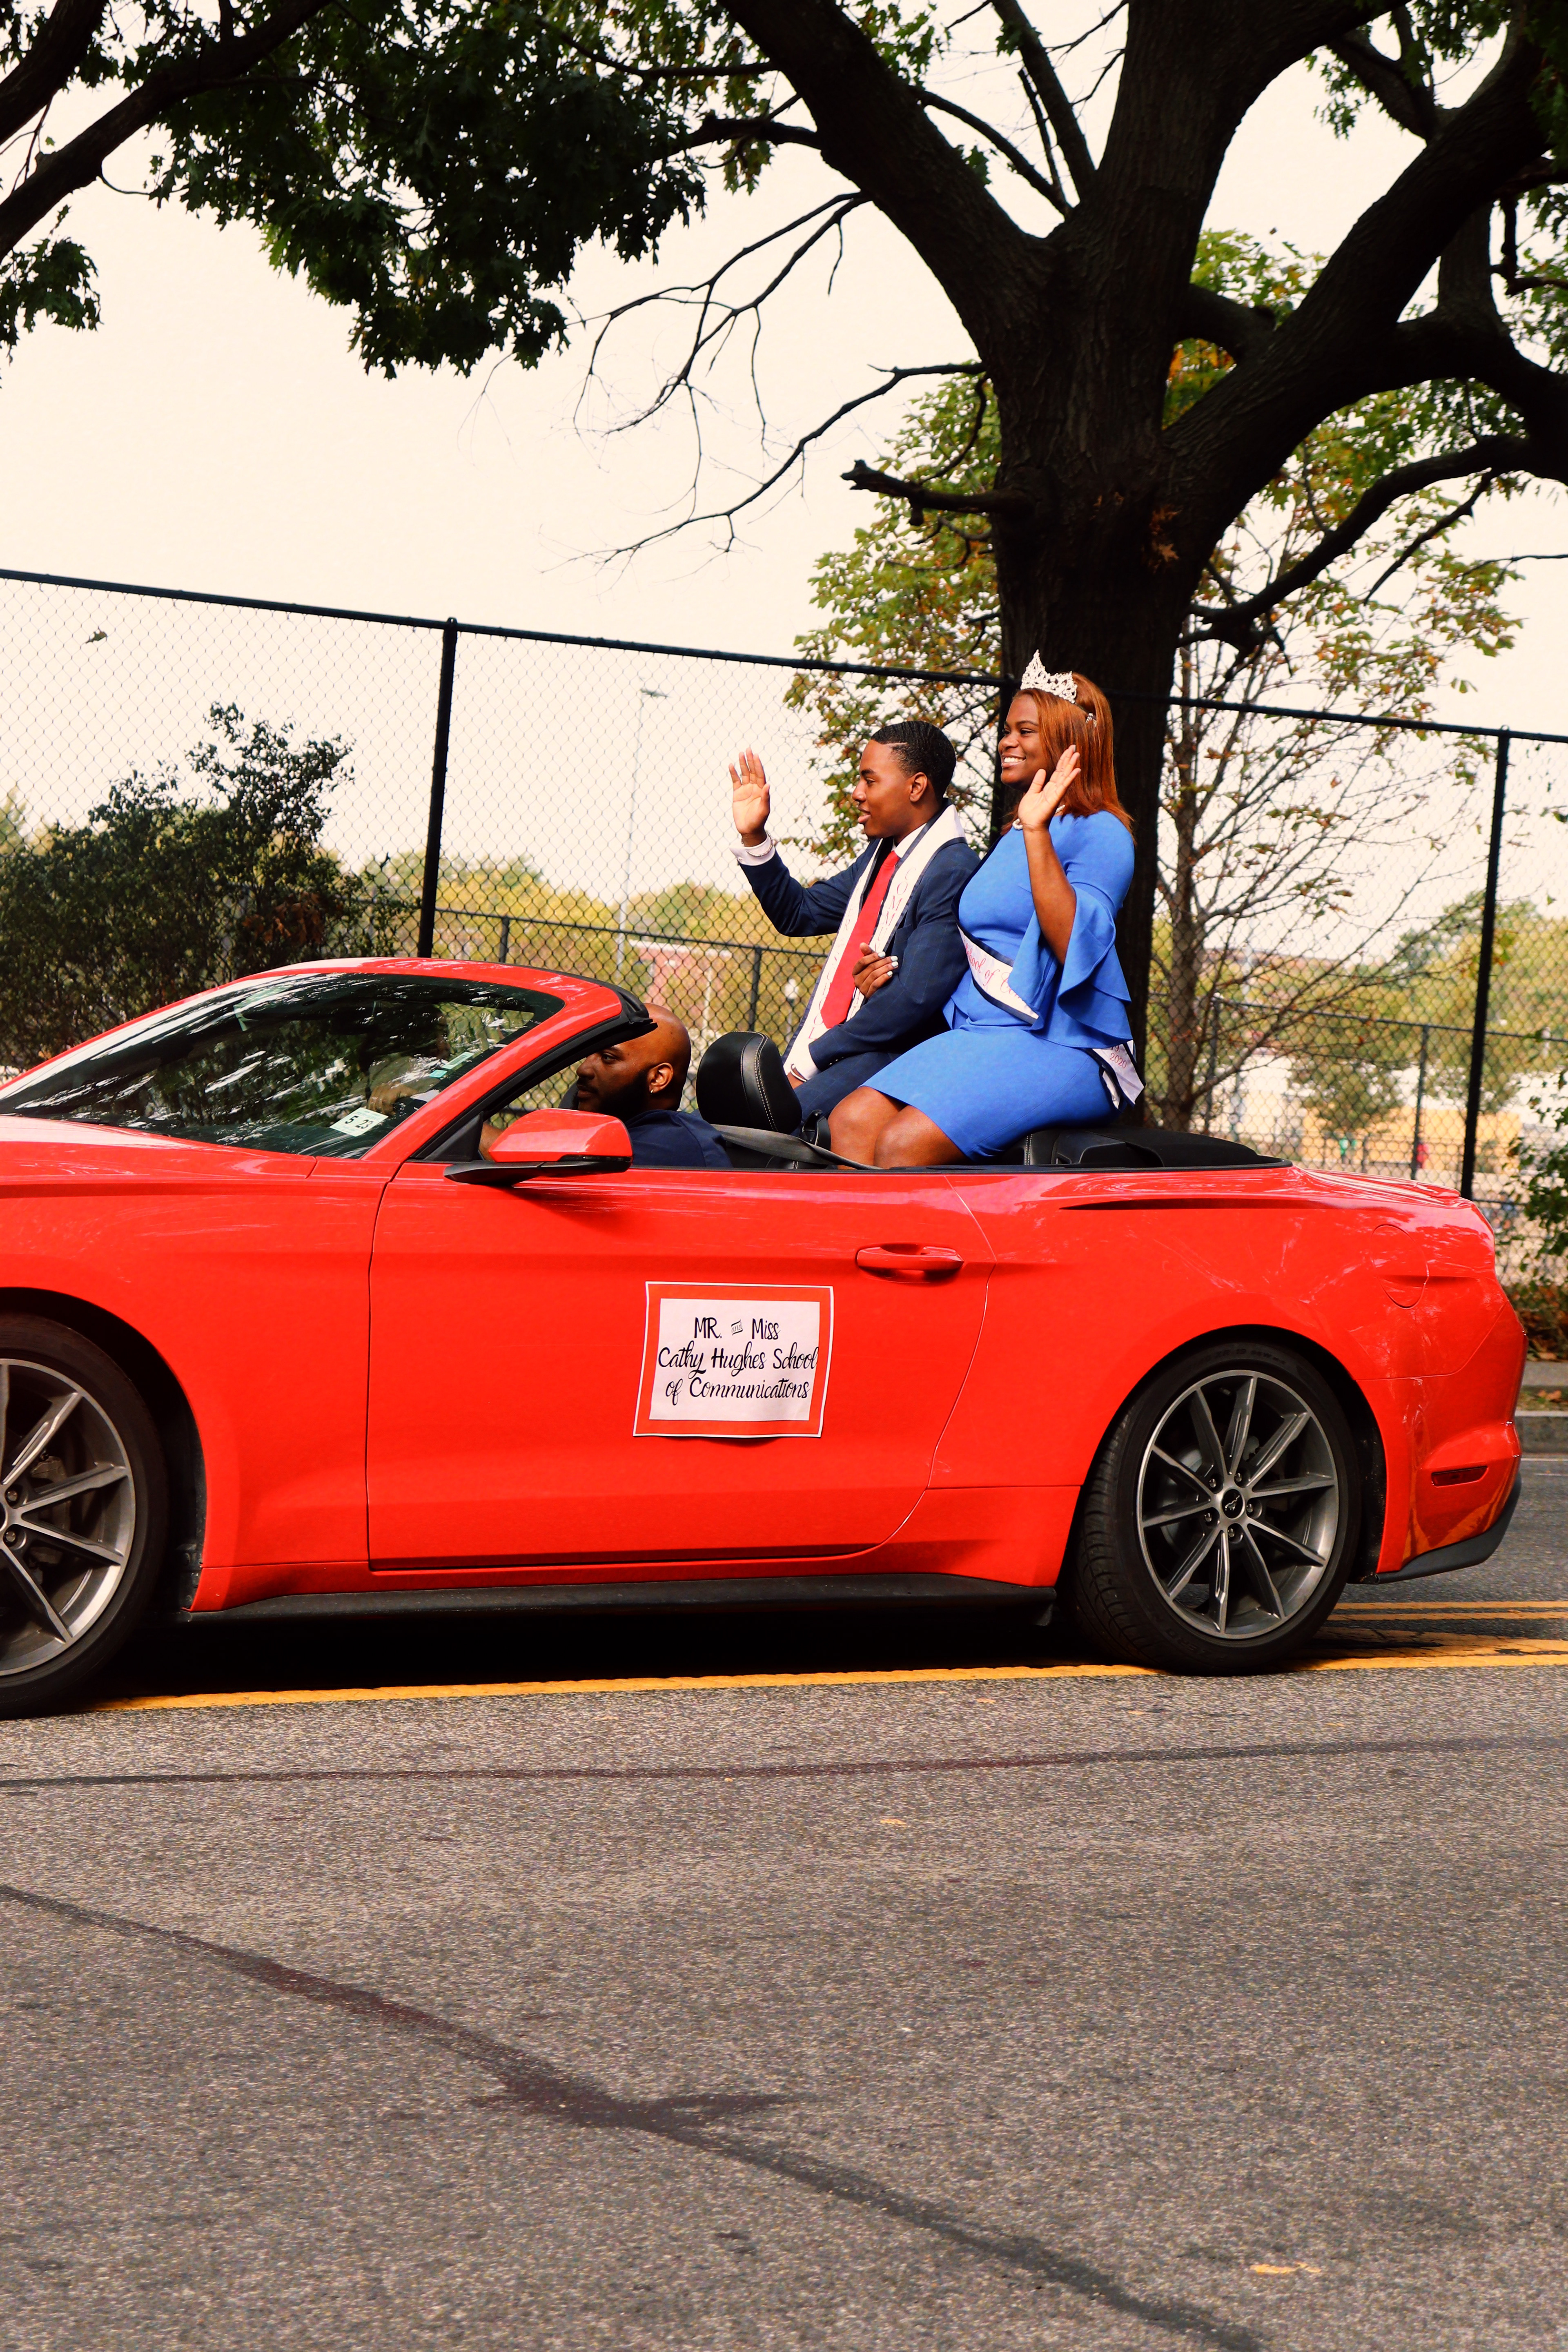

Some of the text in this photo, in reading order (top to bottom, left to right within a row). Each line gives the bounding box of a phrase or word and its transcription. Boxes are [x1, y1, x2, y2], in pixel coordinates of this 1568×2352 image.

[982, 969, 1000, 987] of
[1110, 1052, 1127, 1069] 2020
[345, 1116, 359, 1124] 5
[355, 1119, 374, 1129] 23
[694, 1317, 722, 1339] MR.
[752, 1318, 781, 1340] Miss
[658, 1340, 819, 1379] Cathy Hughes School
[665, 1376, 811, 1406] of Communications
